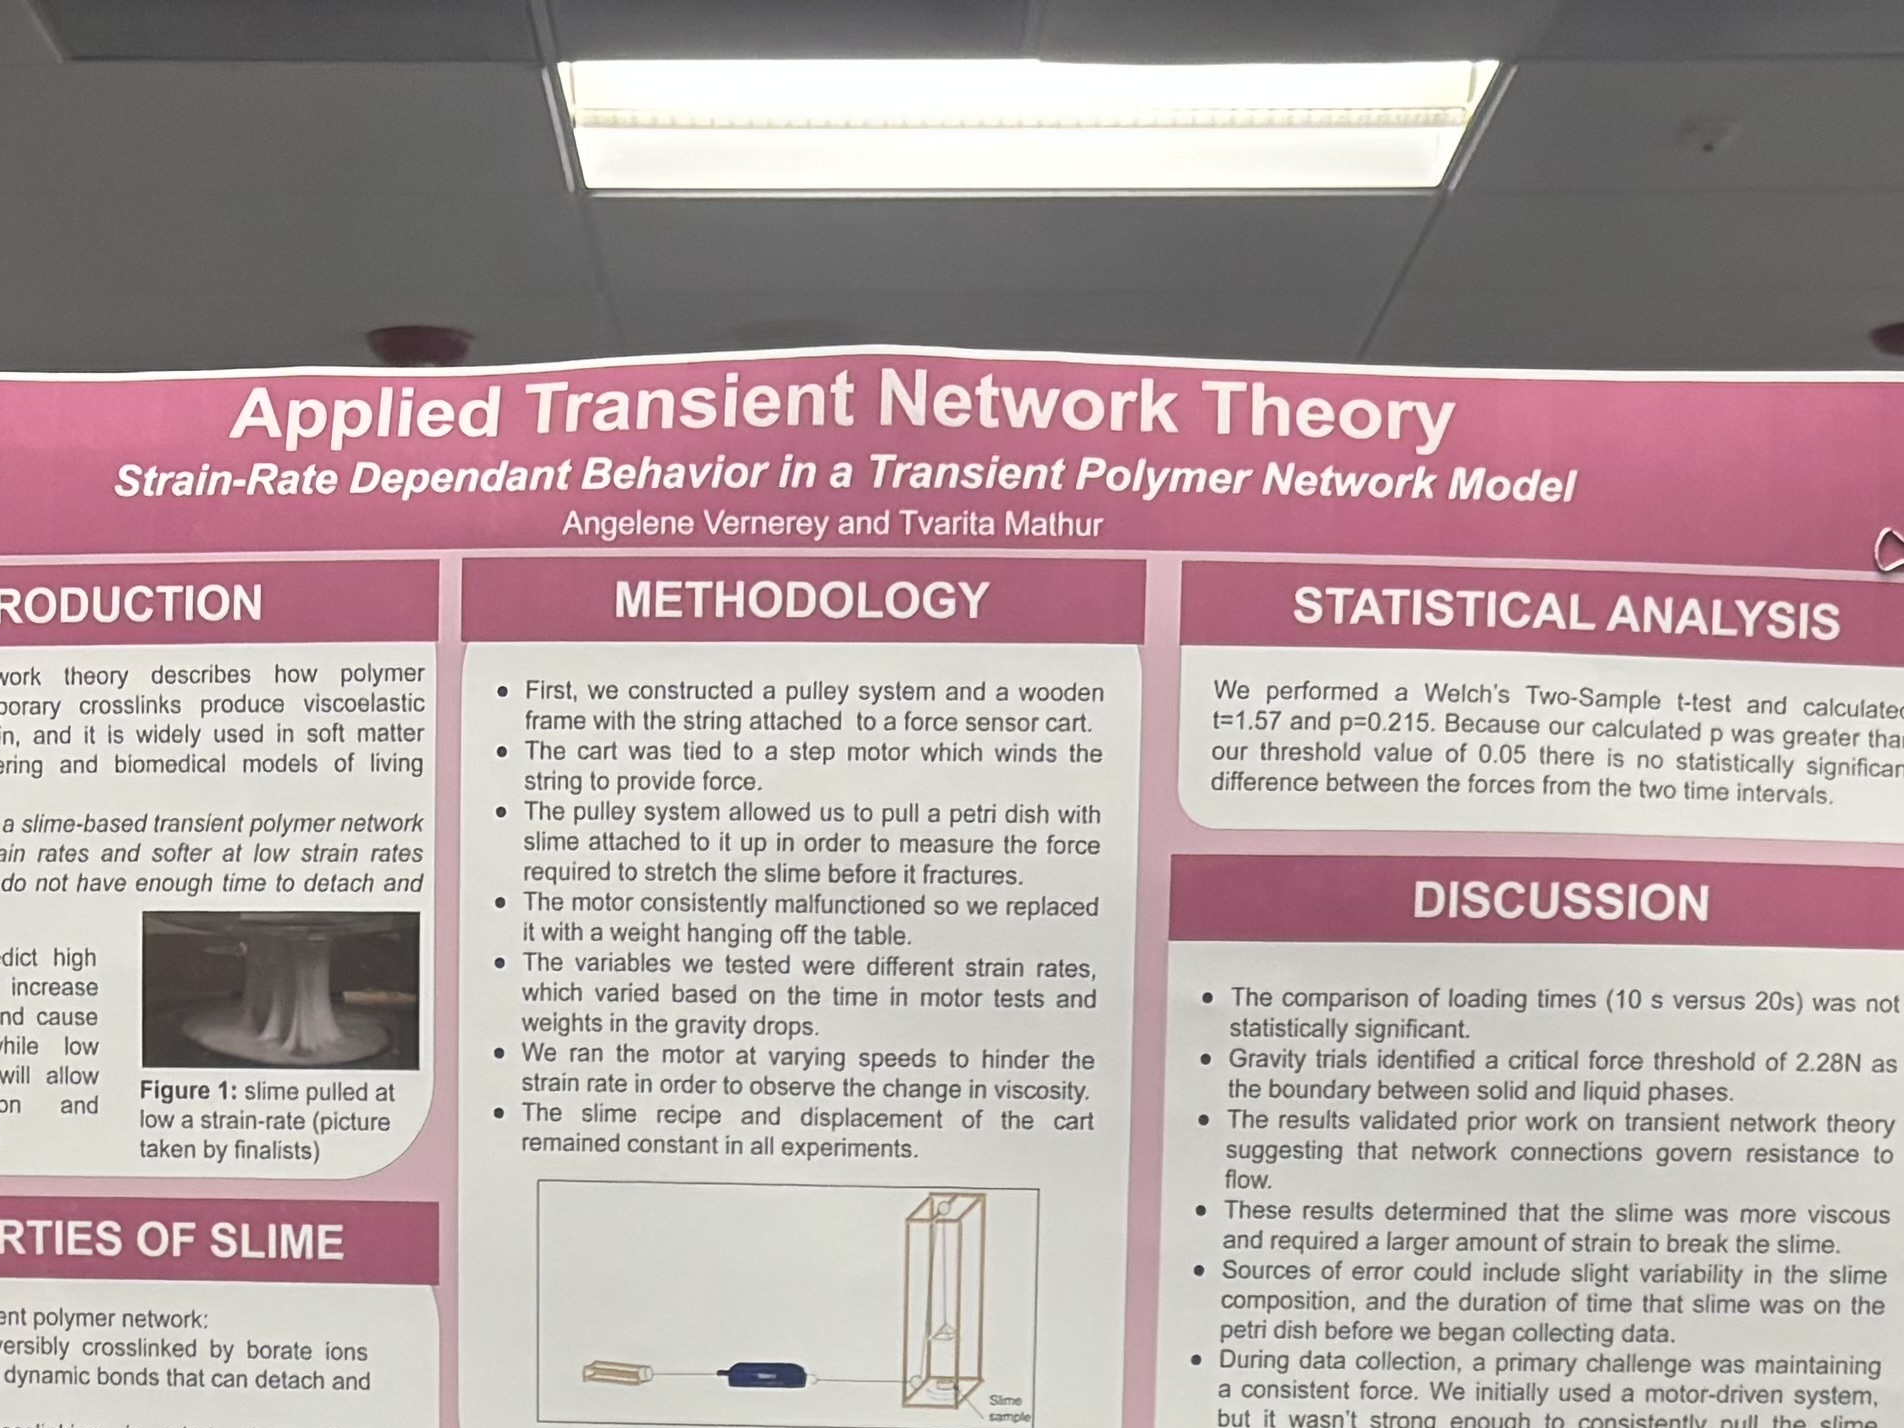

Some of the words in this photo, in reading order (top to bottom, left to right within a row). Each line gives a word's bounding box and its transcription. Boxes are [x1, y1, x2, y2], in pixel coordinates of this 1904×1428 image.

[230, 386, 500, 451] Applied
[525, 370, 854, 433] Transient
[881, 368, 1178, 432] Network
[1202, 381, 1455, 455] Theory
[115, 463, 337, 497] Strain-Rate
[350, 459, 572, 501] Dependant
[582, 455, 770, 489] Behavior
[779, 454, 816, 487] in
[830, 463, 852, 488] a
[869, 454, 1065, 490] Transient
[1076, 457, 1253, 500] Polymer
[1262, 462, 1437, 498] Network
[1449, 467, 1577, 502] Model
[563, 510, 694, 541] Angelene
[704, 510, 829, 541] Vernerey
[839, 510, 889, 535] and
[899, 510, 994, 536] Tvarita
[1004, 510, 1103, 537] Mathur
[615, 581, 990, 619] METHODOLOGY
[1293, 587, 1595, 632] STATISTICAL
[1606, 595, 1840, 640] ANALYSIS
[65, 666, 128, 689] theory
[152, 664, 250, 684] describes
[276, 664, 318, 683] how
[342, 663, 425, 687] polymer
[1214, 710, 1282, 730] t=1.57
[1290, 711, 1330, 730] and
[1340, 712, 1434, 736] p=0.215.
[1446, 713, 1540, 734] Because
[1549, 720, 1584, 736] our
[1592, 717, 1701, 740] calculated
[1710, 725, 1723, 746] p
[1732, 728, 1774, 744] was
[1783, 725, 1860, 750] greater
[525, 770, 582, 795] string
[590, 772, 609, 790] to
[618, 770, 695, 794] provide
[703, 770, 762, 790] force.
[1414, 881, 1709, 922] DISCUSSION
[1230, 1018, 1348, 1042] statistically
[1356, 1018, 1470, 1043] significant.
[137, 1220, 196, 1256] OF
[210, 1221, 345, 1260] SLIME
